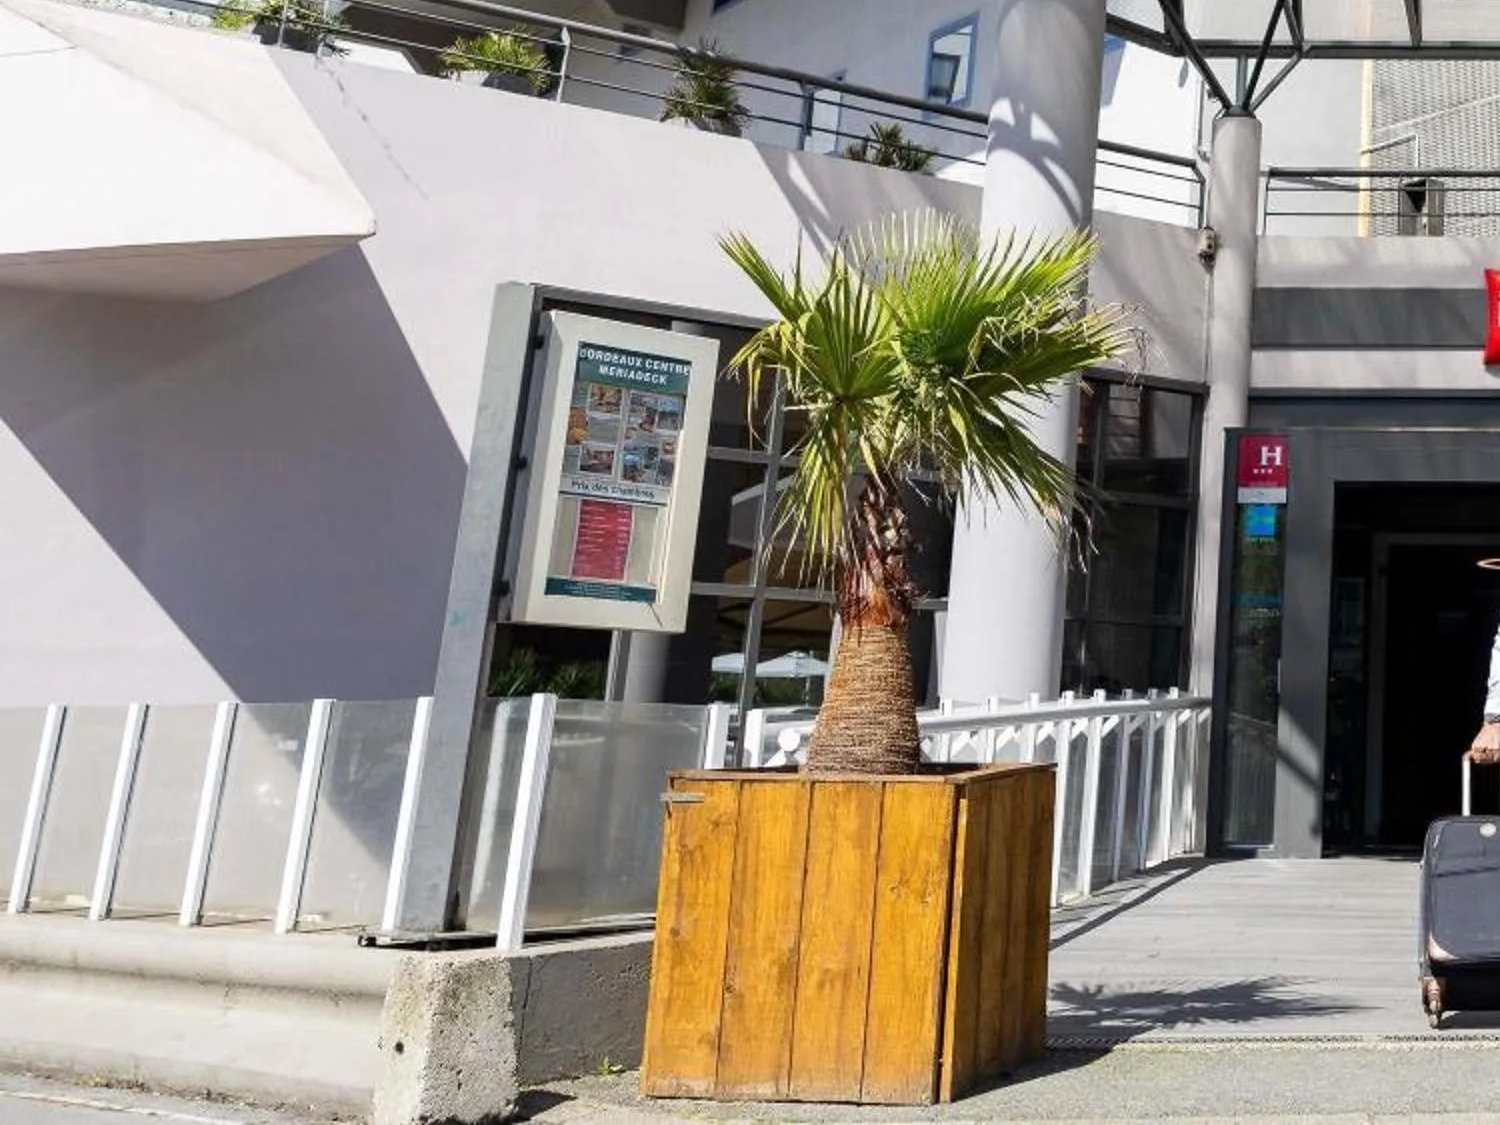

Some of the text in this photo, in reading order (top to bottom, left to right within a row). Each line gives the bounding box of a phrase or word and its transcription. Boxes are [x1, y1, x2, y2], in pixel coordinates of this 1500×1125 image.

[579, 348, 690, 376] BORDEAUX CENTRE
[599, 364, 668, 385] MERIADECK
[1260, 446, 1283, 466] H
